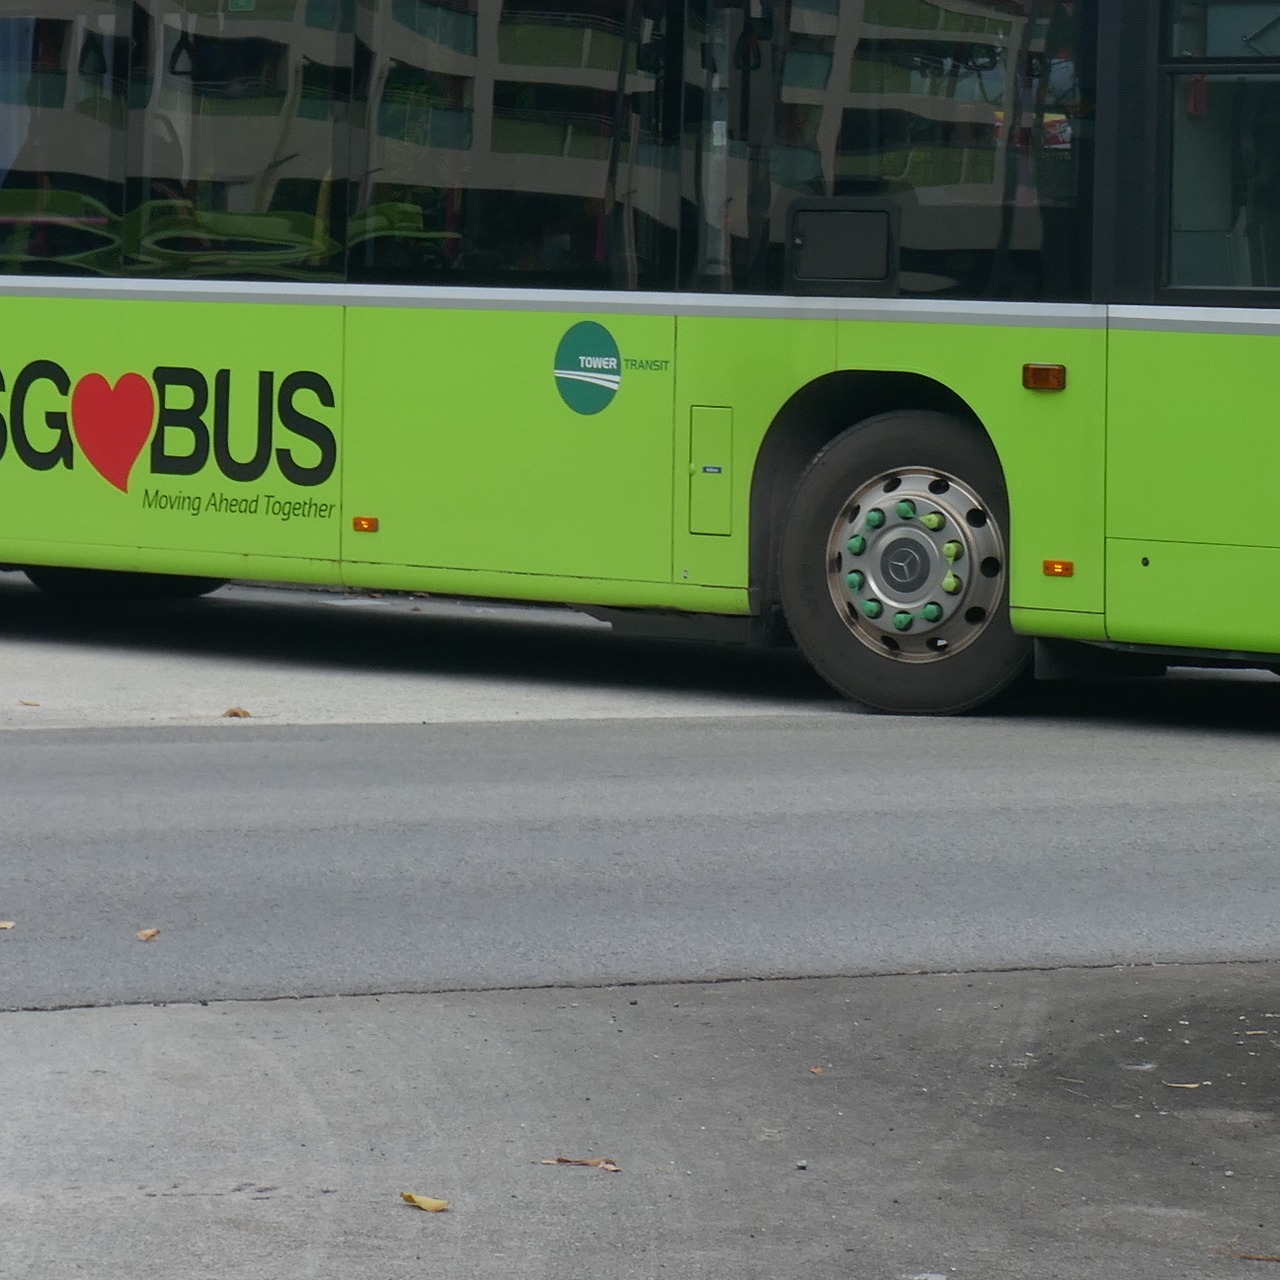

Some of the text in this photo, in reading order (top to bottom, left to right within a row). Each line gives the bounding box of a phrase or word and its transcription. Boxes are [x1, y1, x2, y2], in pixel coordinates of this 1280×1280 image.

[578, 355, 671, 372] TOWER TRANSIT
[141, 488, 336, 522] Moving Ahead Together
